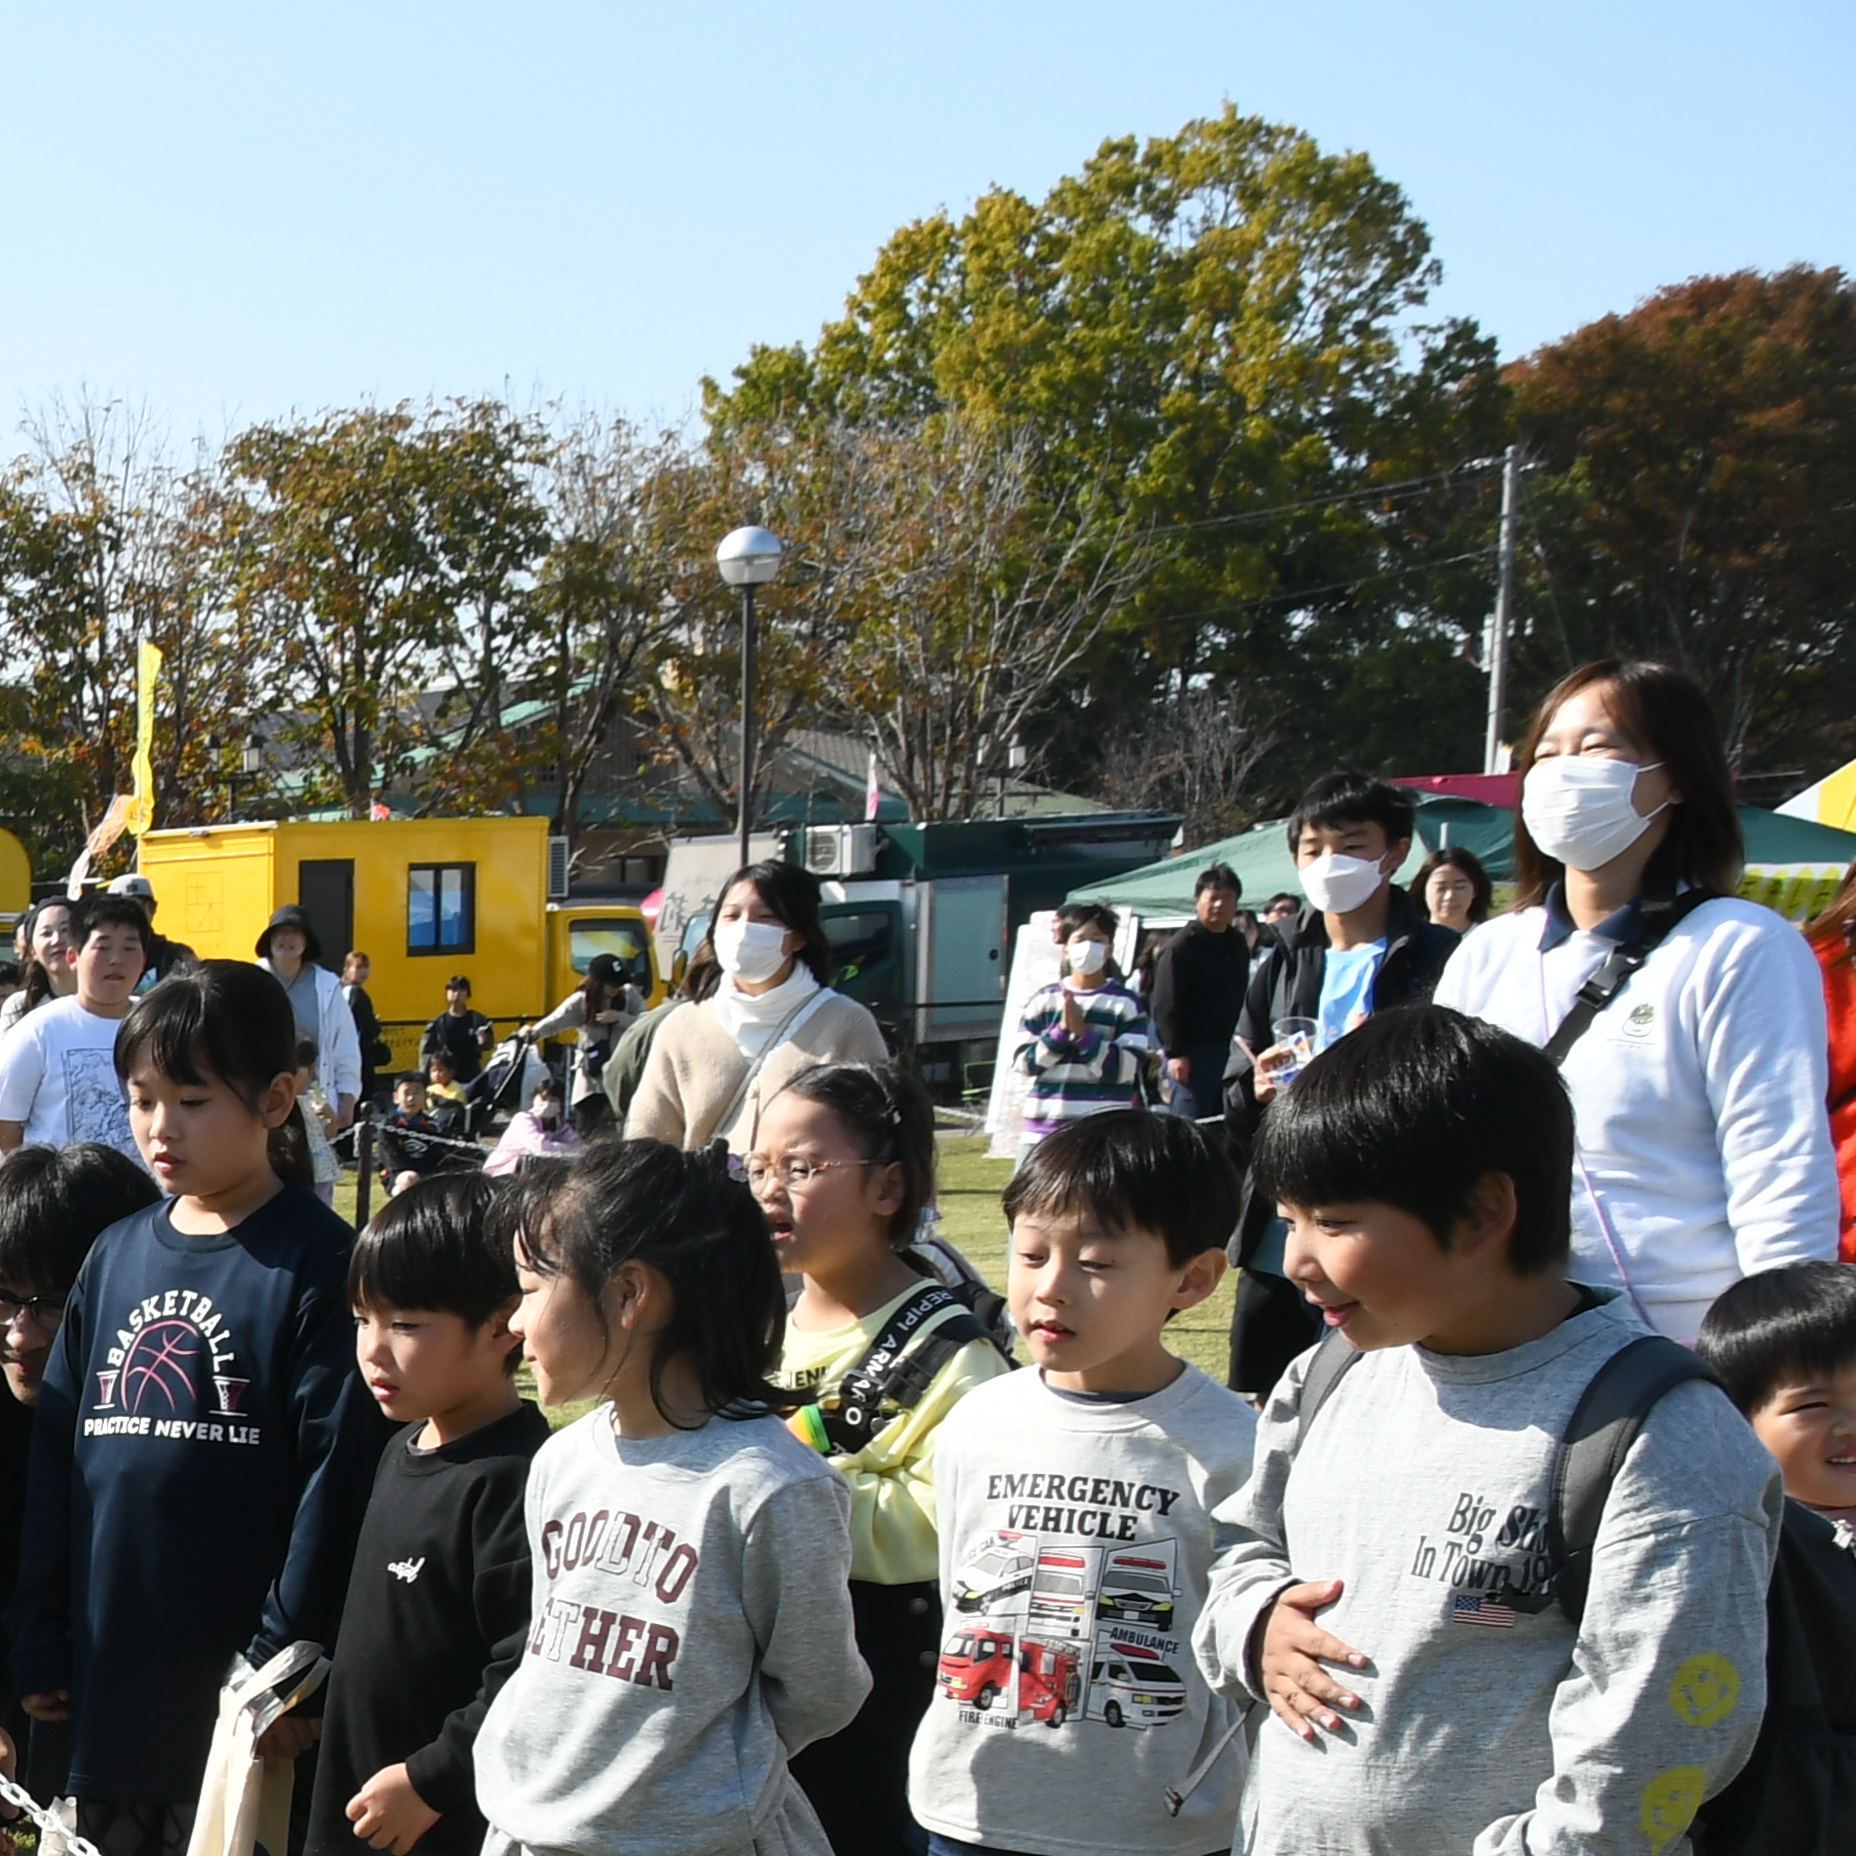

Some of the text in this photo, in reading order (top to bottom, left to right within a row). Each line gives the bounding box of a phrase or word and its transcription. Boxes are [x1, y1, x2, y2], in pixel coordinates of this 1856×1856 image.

[107, 1289, 235, 1373] BASKETBALL
[84, 1416, 261, 1445] PRACTICE NEVER LIE
[987, 1473, 1181, 1516] EMERGENCY
[1007, 1504, 1139, 1541] VEHICLE
[1446, 1492, 1497, 1555] Big
[1410, 1535, 1437, 1579] In
[1439, 1540, 1511, 1591] Town
[1110, 1627, 1180, 1655] AMBULANCE
[959, 1710, 982, 1725] FIRE
